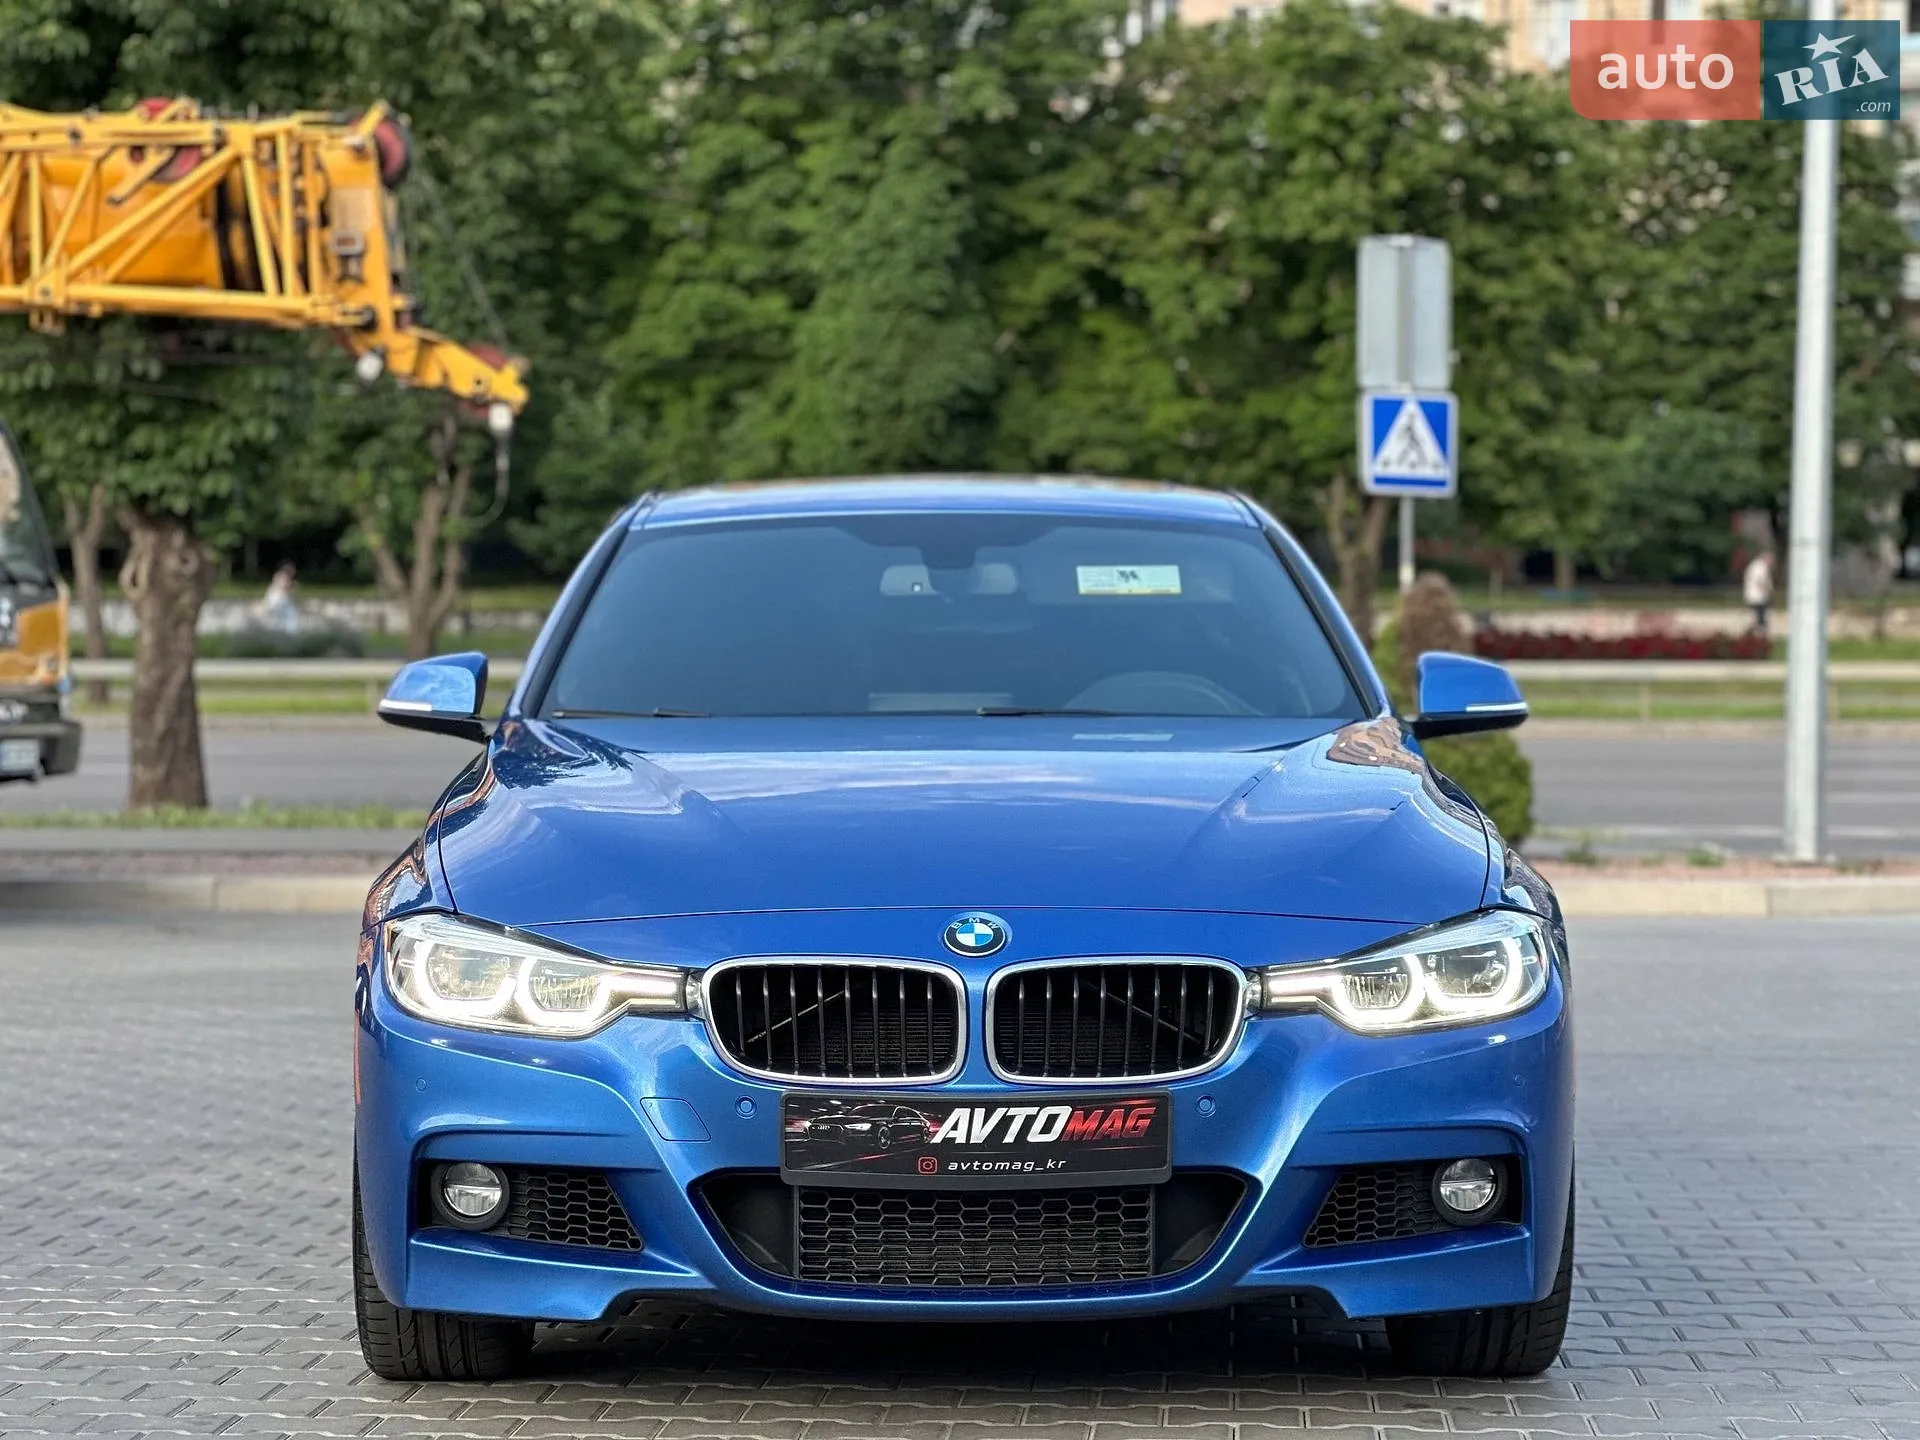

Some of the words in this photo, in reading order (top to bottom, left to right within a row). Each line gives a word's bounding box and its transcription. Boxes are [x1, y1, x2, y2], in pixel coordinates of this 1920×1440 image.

[951, 917, 1000, 929] BMW
[930, 1105, 1157, 1144] AVTOMAG
[947, 1158, 1067, 1174] avtomag_kr
